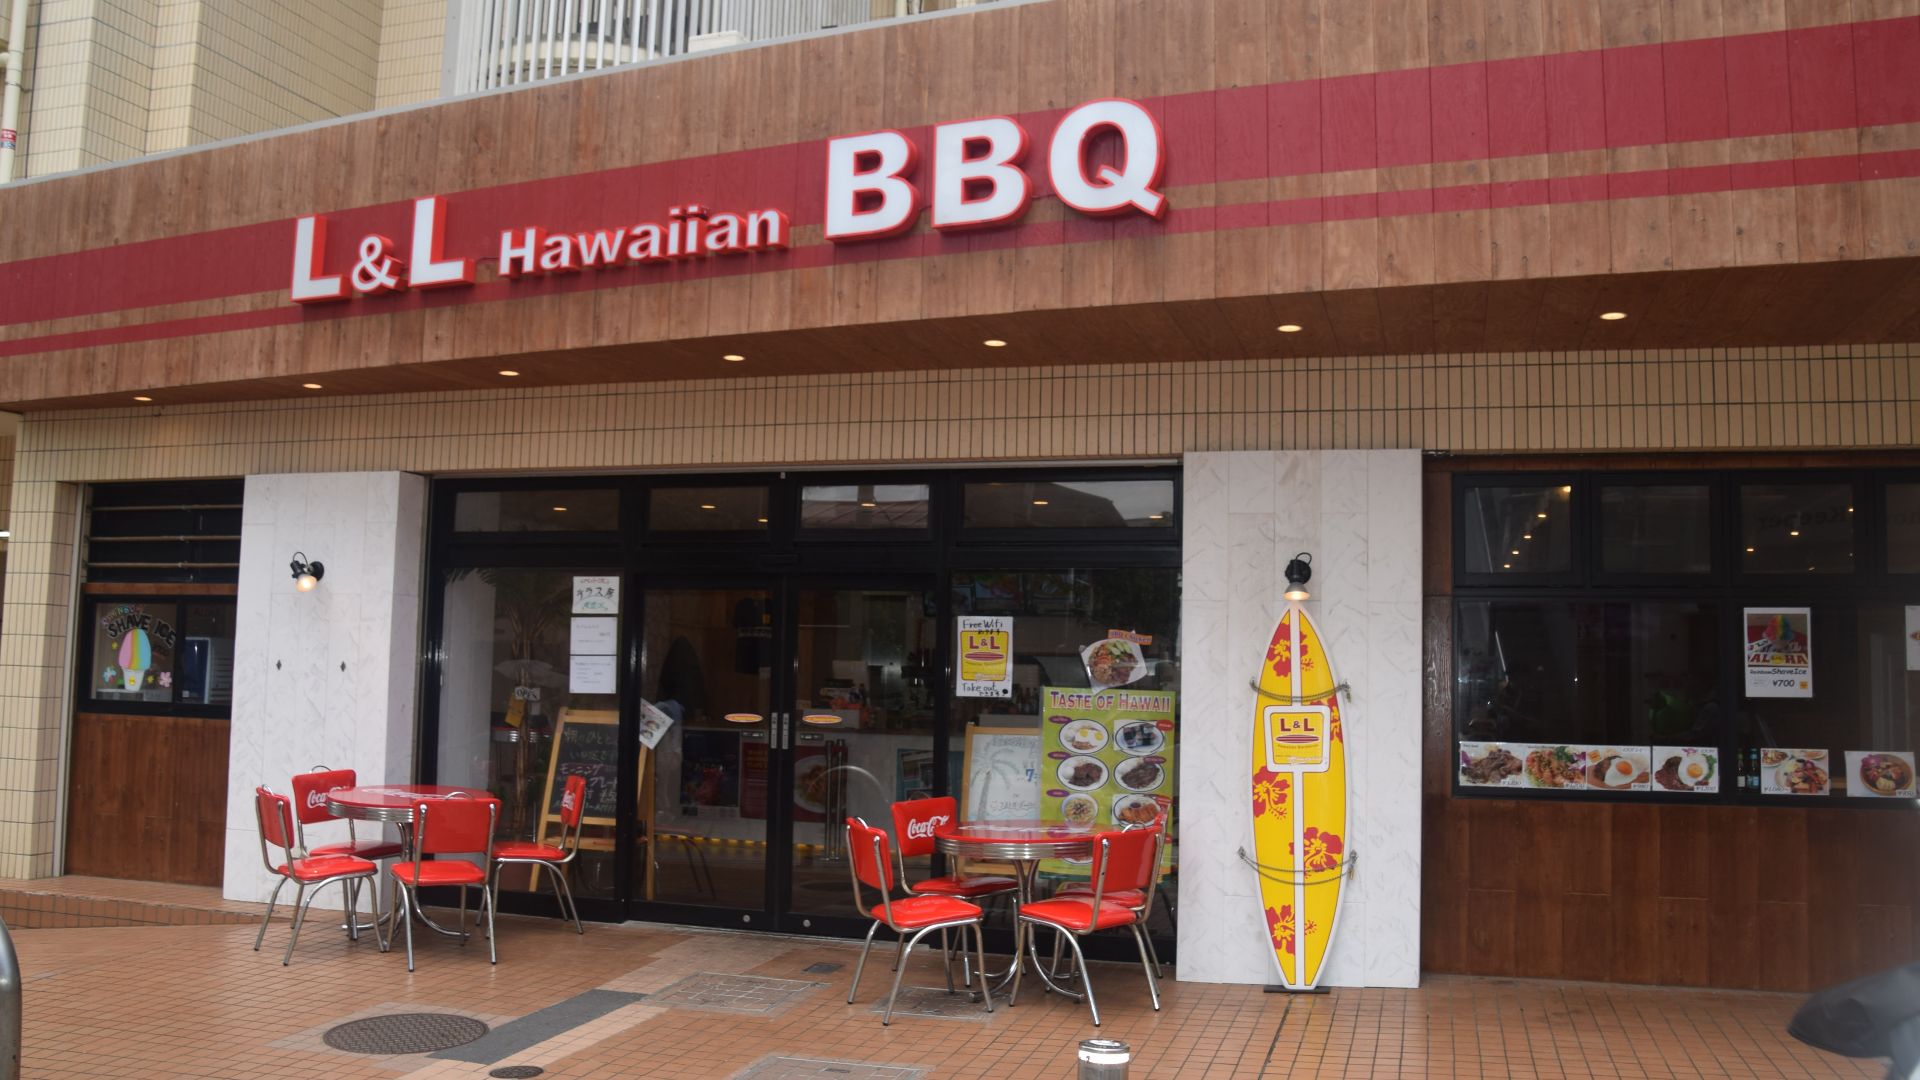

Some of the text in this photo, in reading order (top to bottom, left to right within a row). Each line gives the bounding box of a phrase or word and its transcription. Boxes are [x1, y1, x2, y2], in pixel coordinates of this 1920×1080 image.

[291, 98, 1167, 303] L&L Hawaiian BBQ
[106, 613, 177, 648] SHAVE ICE
[962, 619, 982, 629] Free
[969, 635, 1001, 650] L&L
[962, 682, 982, 693] Take
[1772, 679, 1795, 688] ¥700
[1050, 690, 1171, 712] TASTE OF HAWAII
[1280, 717, 1315, 732] L&L
[907, 815, 950, 840] Coca-C
